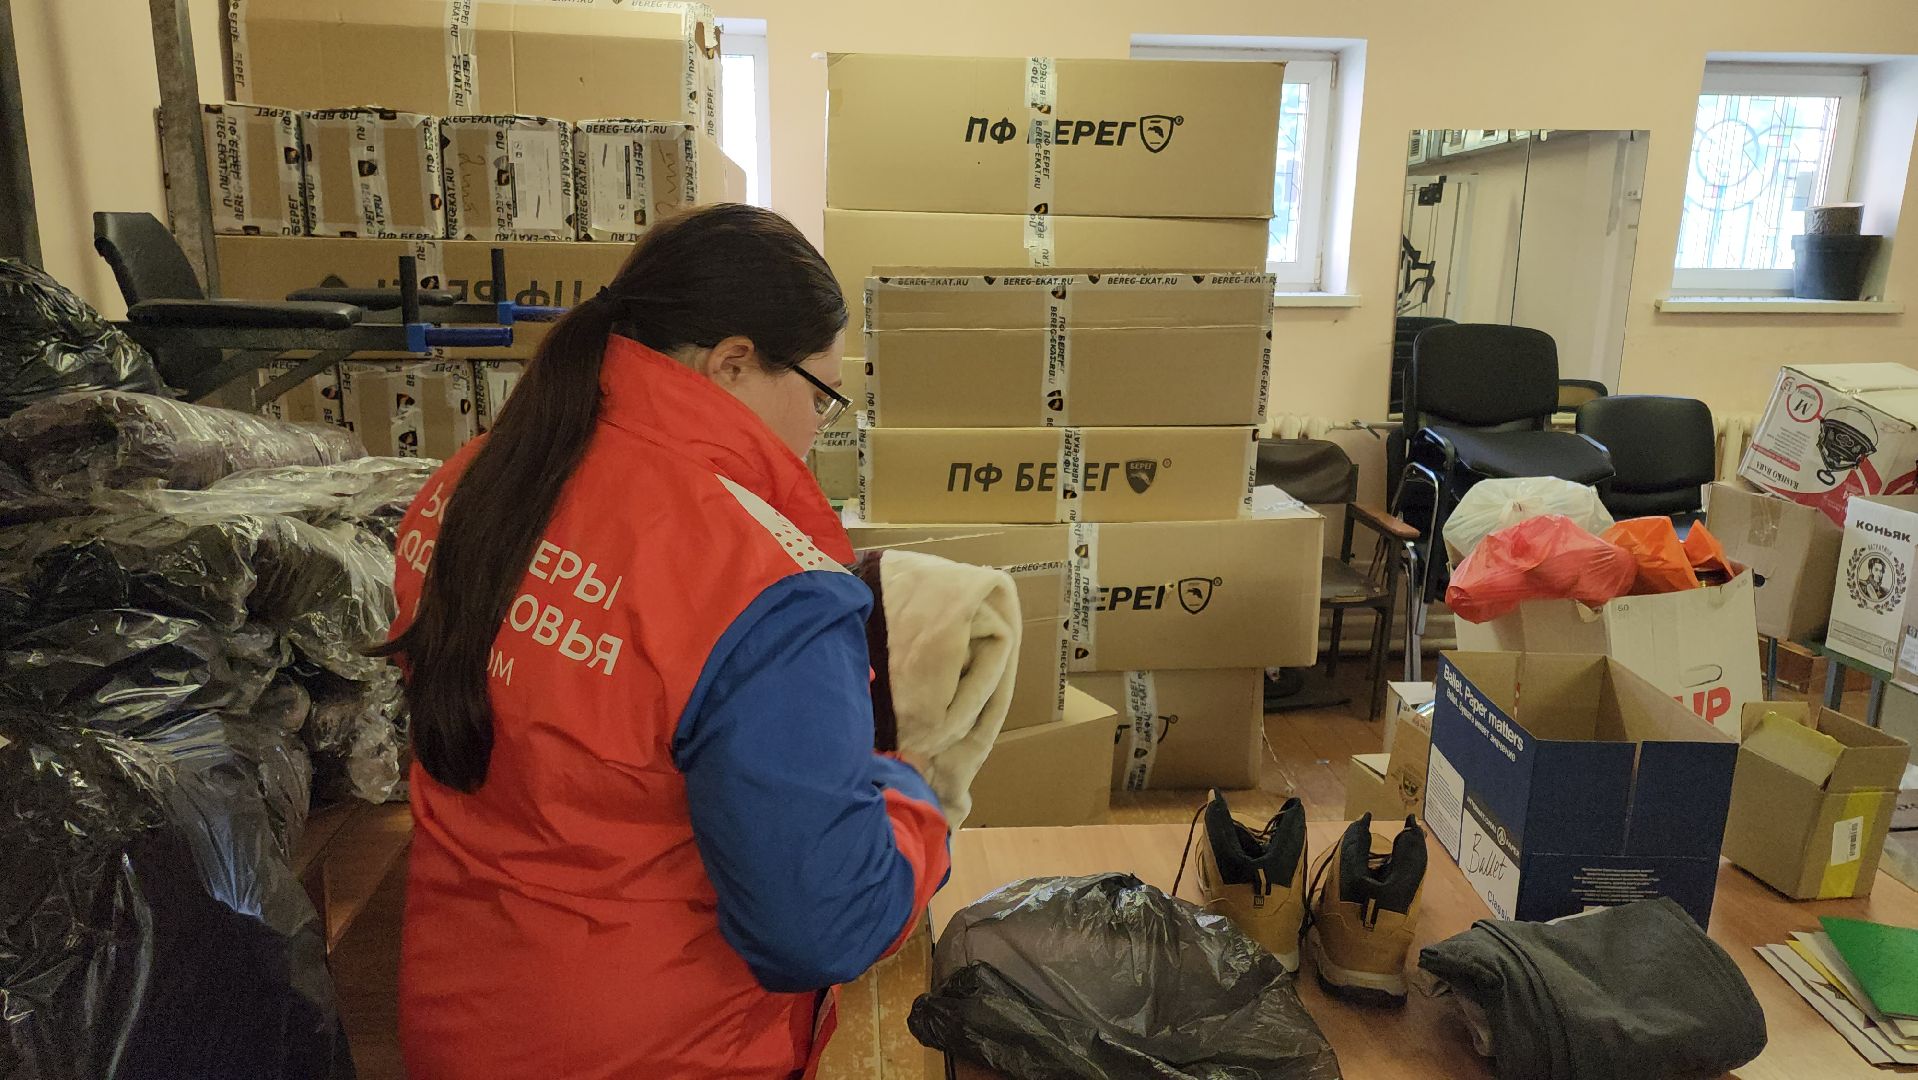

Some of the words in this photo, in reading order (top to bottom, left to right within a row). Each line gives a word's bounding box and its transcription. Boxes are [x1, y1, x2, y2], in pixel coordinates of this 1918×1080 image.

[585, 124, 667, 134] BEREG-EKAT.RU
[965, 116, 1017, 144] ПФ
[1027, 119, 1137, 146] ЕРЕГ
[1043, 130, 1051, 146] ПФ
[1033, 120, 1043, 190] BEREG-EKAT.RU
[1042, 150, 1051, 180] БЕРЕГ
[1003, 278, 1074, 286] BEREG-EKAT.RU
[1107, 277, 1178, 285] BEREG-EKAT.RU
[947, 463, 1003, 491] ПФ
[1015, 463, 1119, 492] БЕЕГ
[1855, 519, 1911, 543] КОНЬЯК
[1464, 685, 1488, 719] Paper
[1488, 711, 1524, 752] matters
[1466, 832, 1508, 881] Ballet
